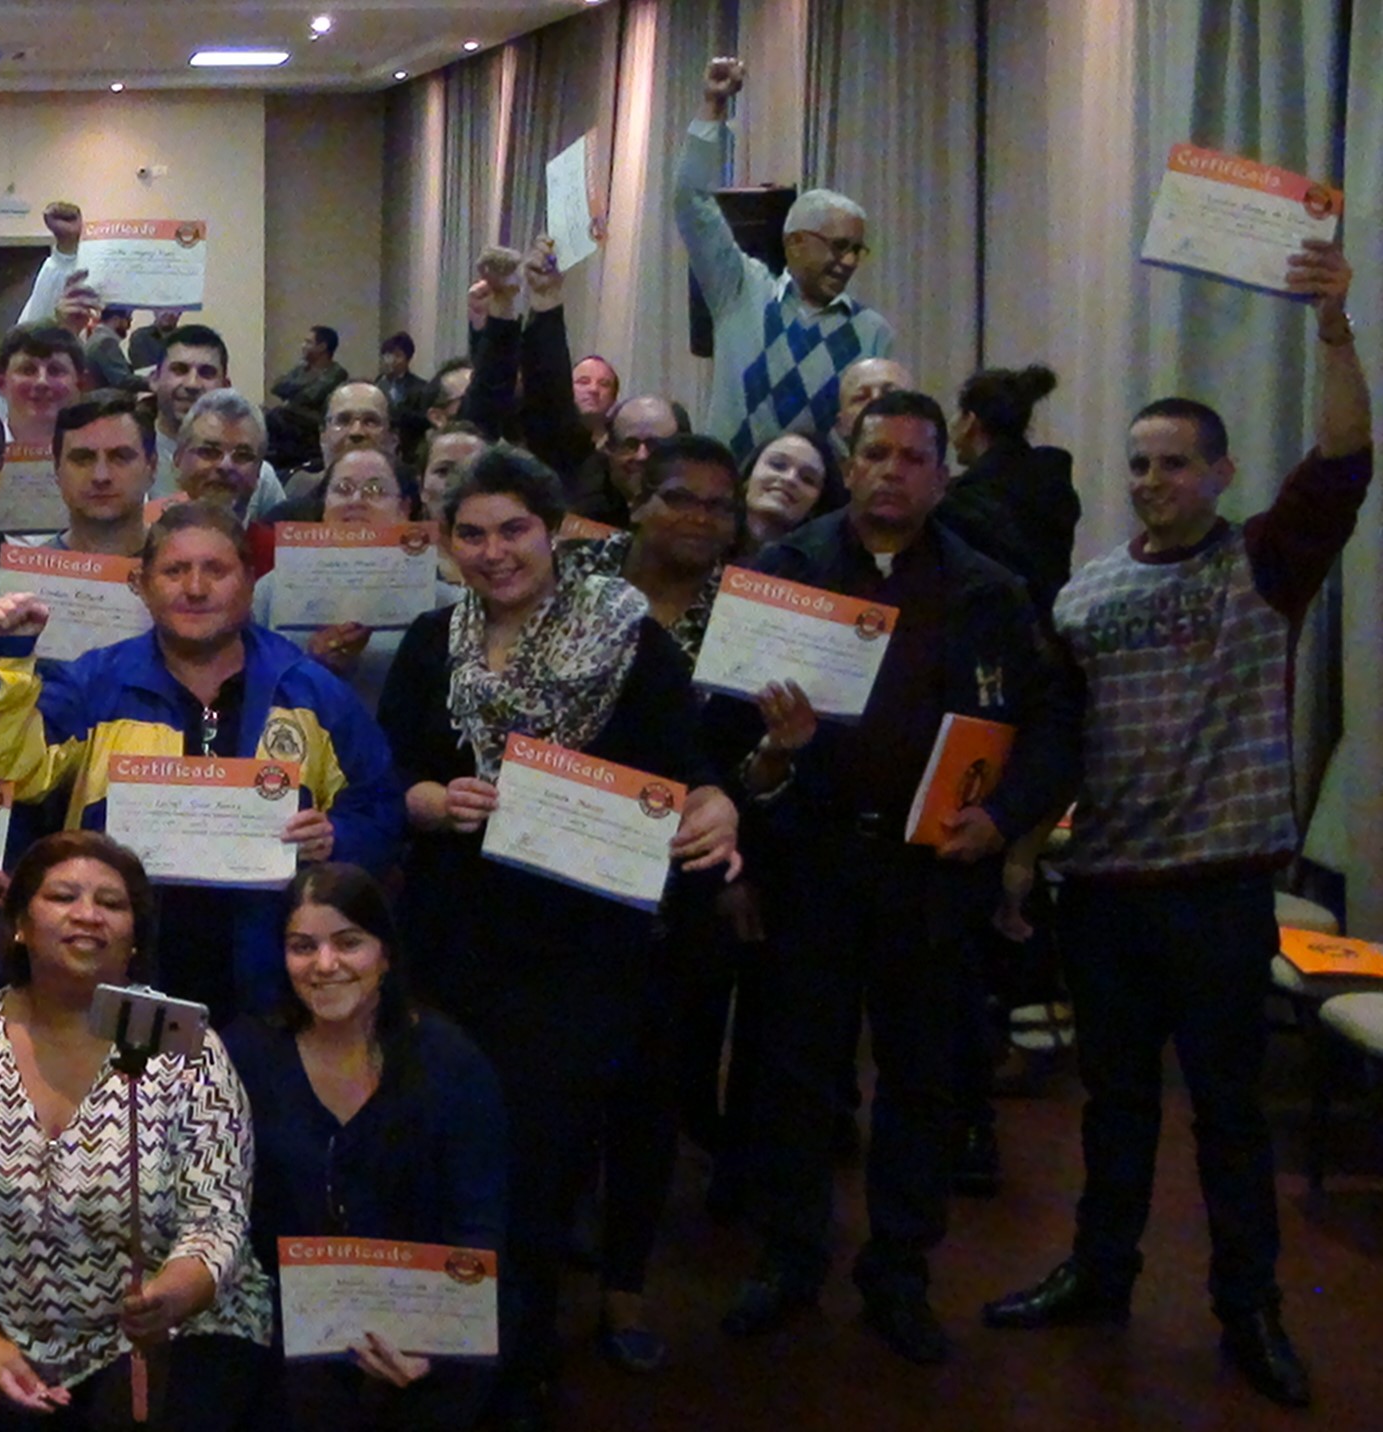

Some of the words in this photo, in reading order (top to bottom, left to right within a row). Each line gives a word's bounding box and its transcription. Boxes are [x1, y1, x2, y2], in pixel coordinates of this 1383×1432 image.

[1176, 149, 1282, 188] Certificado
[85, 222, 156, 236] Certificado
[281, 525, 377, 542] Certificado
[5, 549, 103, 574] Certificado
[729, 572, 836, 613] Certificado
[116, 759, 227, 779] Certificado
[513, 740, 616, 784] Certificado
[287, 1243, 414, 1263] Certificado
